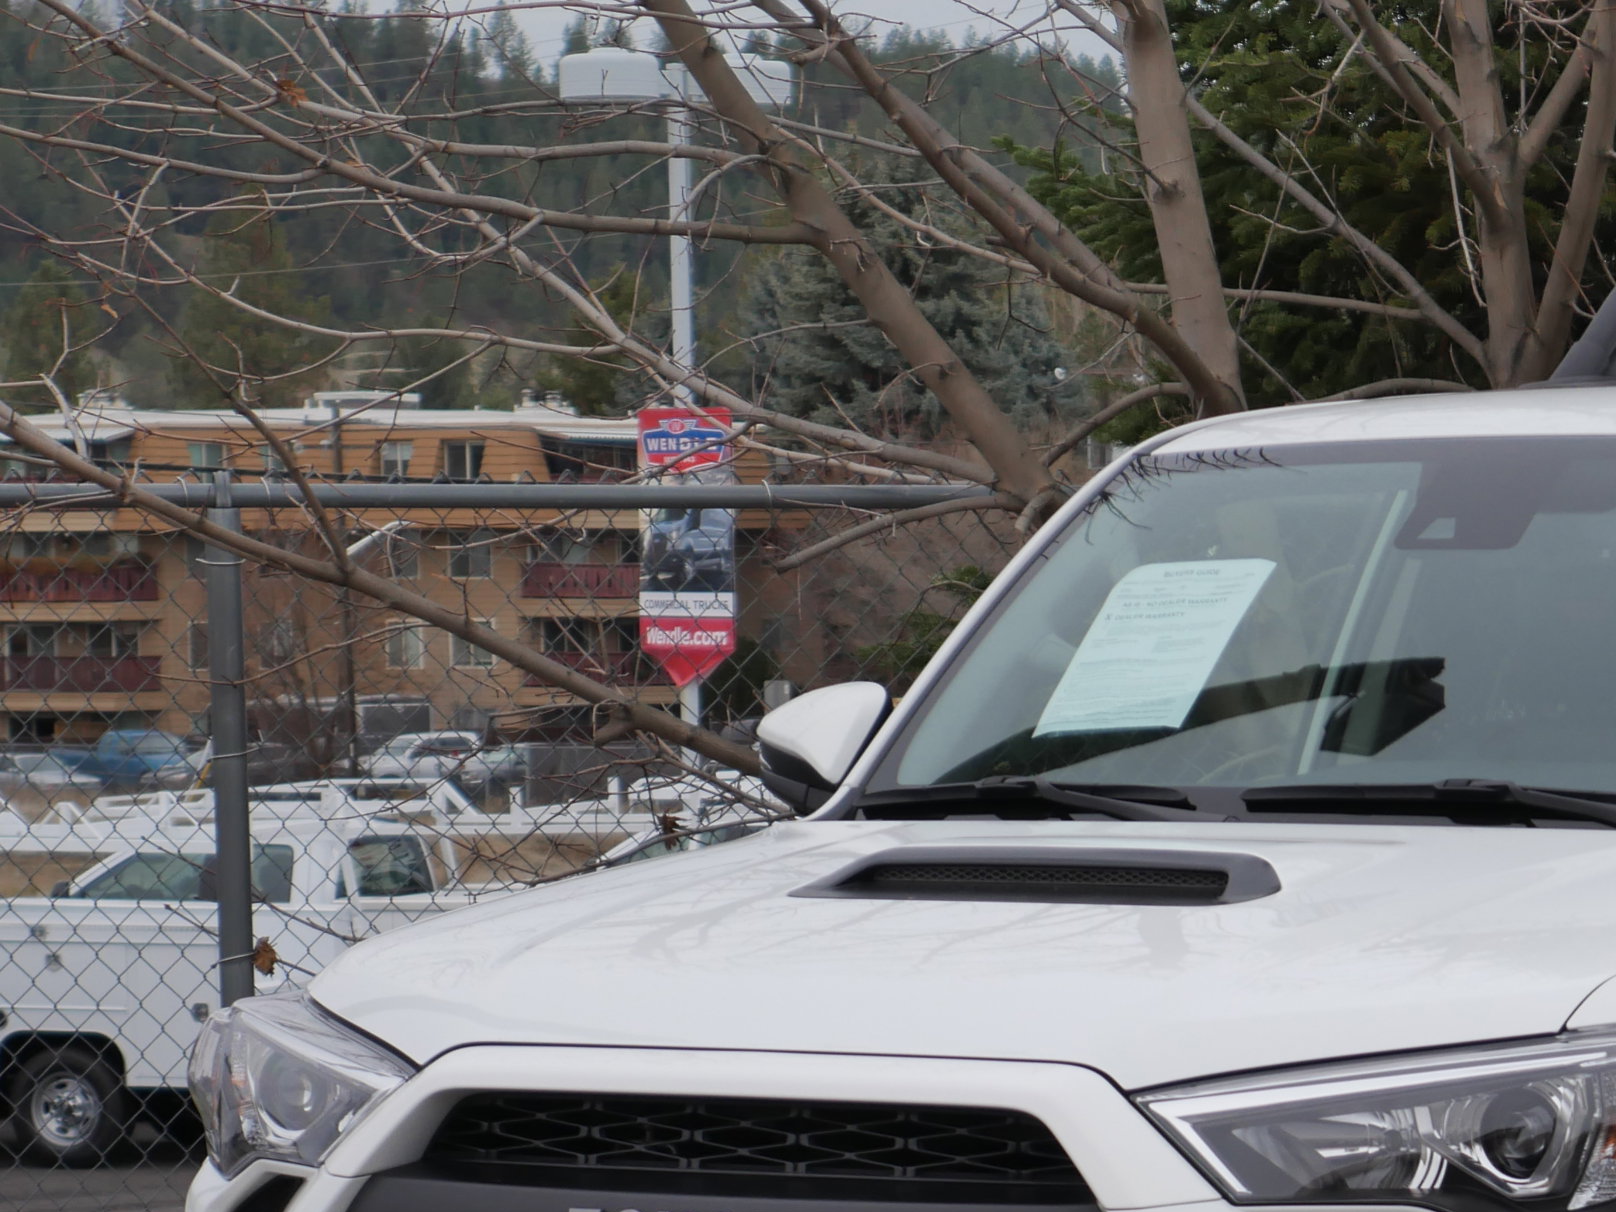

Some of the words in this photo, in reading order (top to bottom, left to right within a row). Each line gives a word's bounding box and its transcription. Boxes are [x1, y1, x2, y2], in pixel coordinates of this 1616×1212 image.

[644, 599, 691, 609] COMMERCIAL
[693, 600, 729, 609] TRUCKS
[646, 626, 728, 645] iWendle.com
